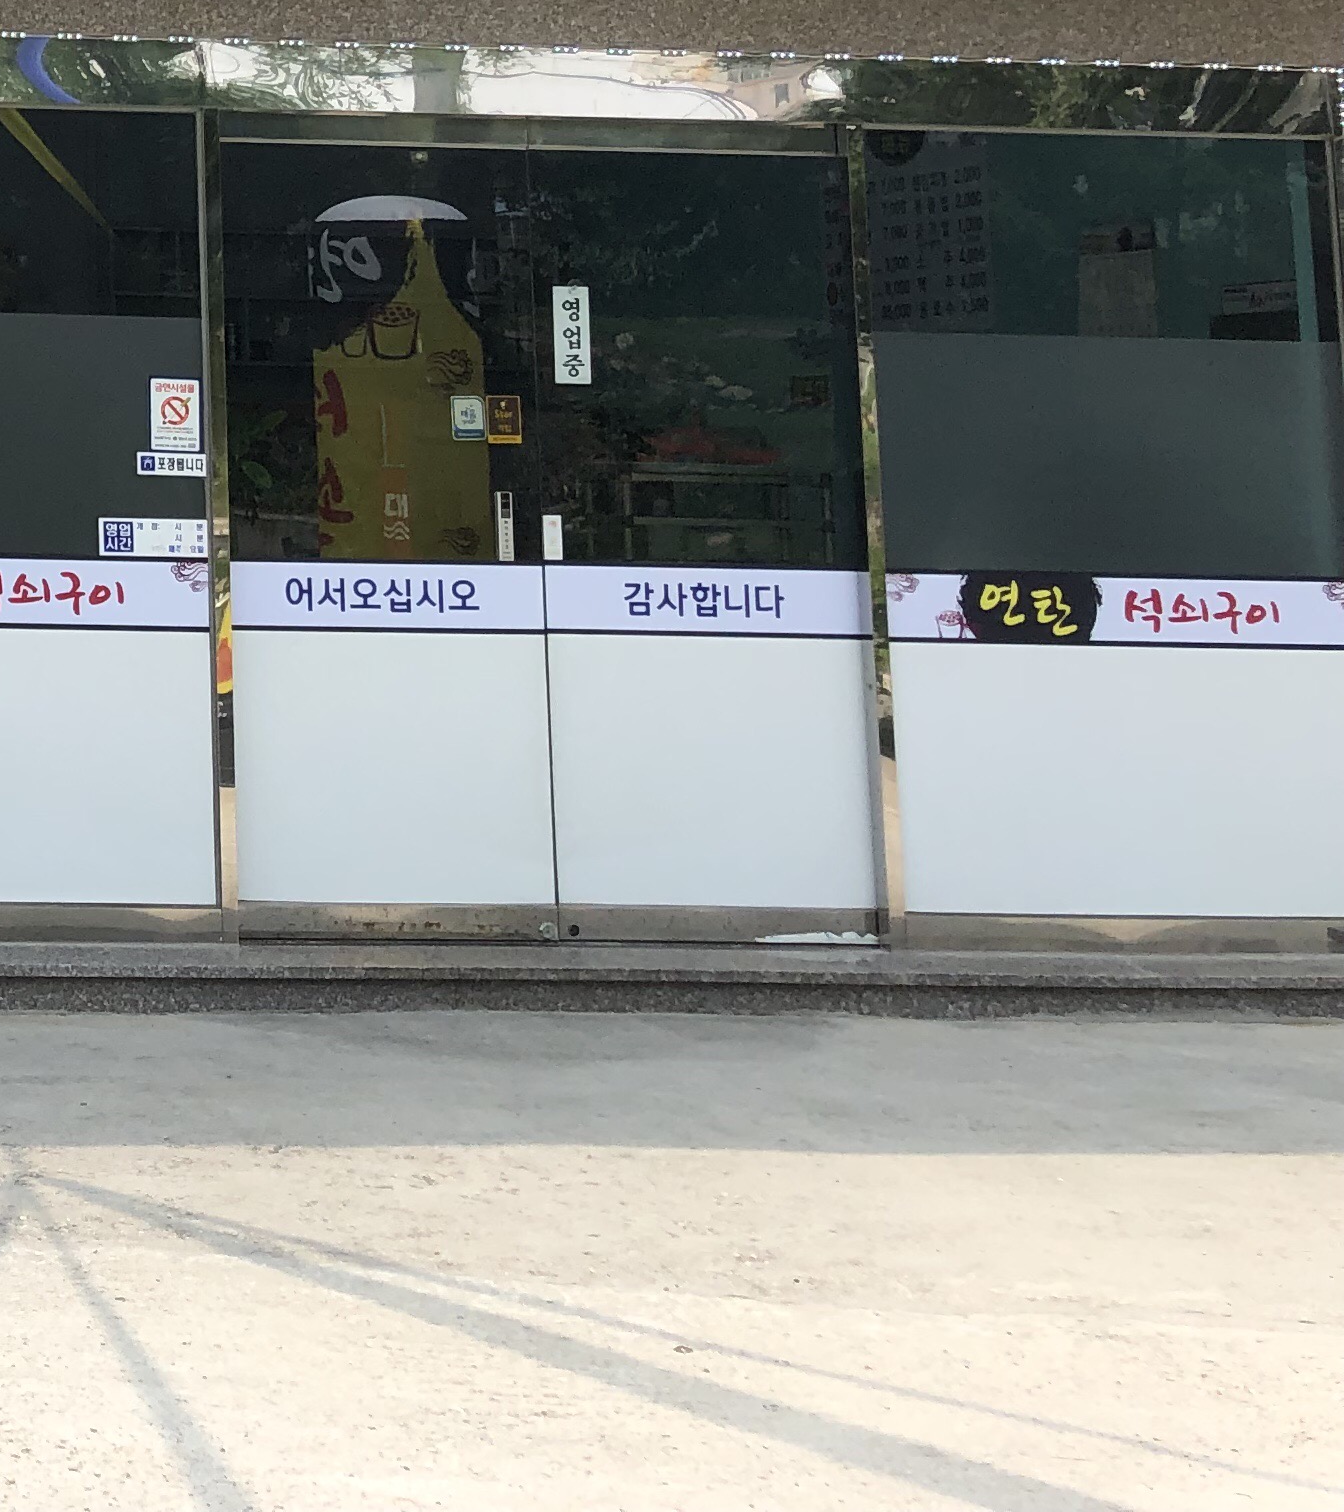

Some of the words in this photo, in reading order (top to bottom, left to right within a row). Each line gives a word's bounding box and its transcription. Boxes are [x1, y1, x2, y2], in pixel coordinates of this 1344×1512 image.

[562, 297, 585, 378] 영업중
[157, 457, 204, 473] 포장됩니다
[105, 522, 132, 537] 영업
[105, 537, 132, 551] 시간
[284, 575, 481, 615] 어서오십시오
[622, 580, 787, 620] 감사합니다
[978, 580, 1078, 637] 연탄
[1123, 588, 1281, 634] 석쇠구이
